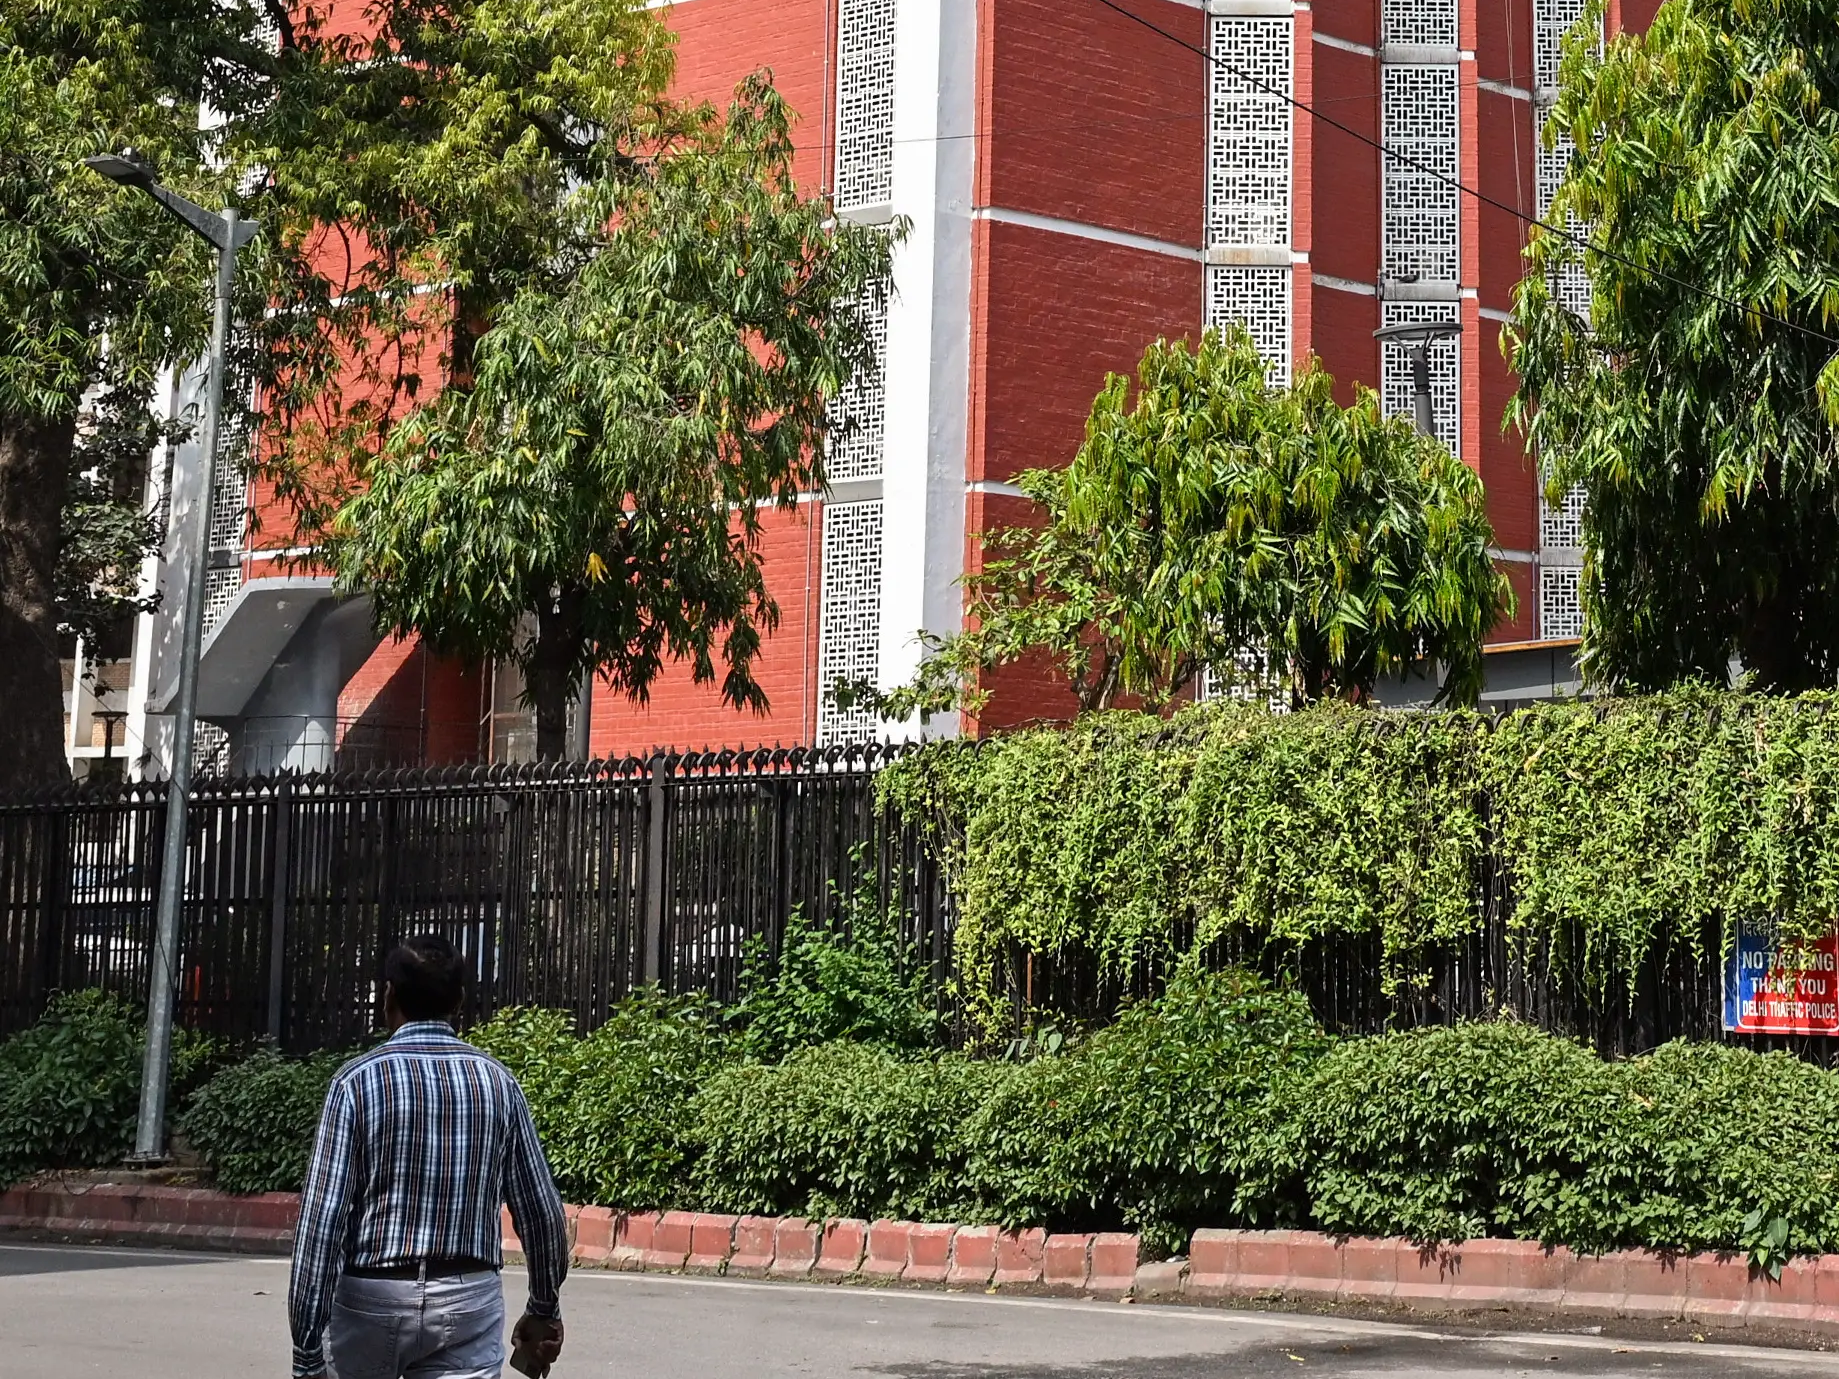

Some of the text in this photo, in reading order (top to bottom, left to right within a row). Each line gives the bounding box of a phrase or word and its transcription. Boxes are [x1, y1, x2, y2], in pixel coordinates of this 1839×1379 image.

[1742, 951, 1764, 970] NO
[1799, 978, 1827, 996] YOU
[1742, 1000, 1836, 1019] DELHI TRAFFIC POLICE
